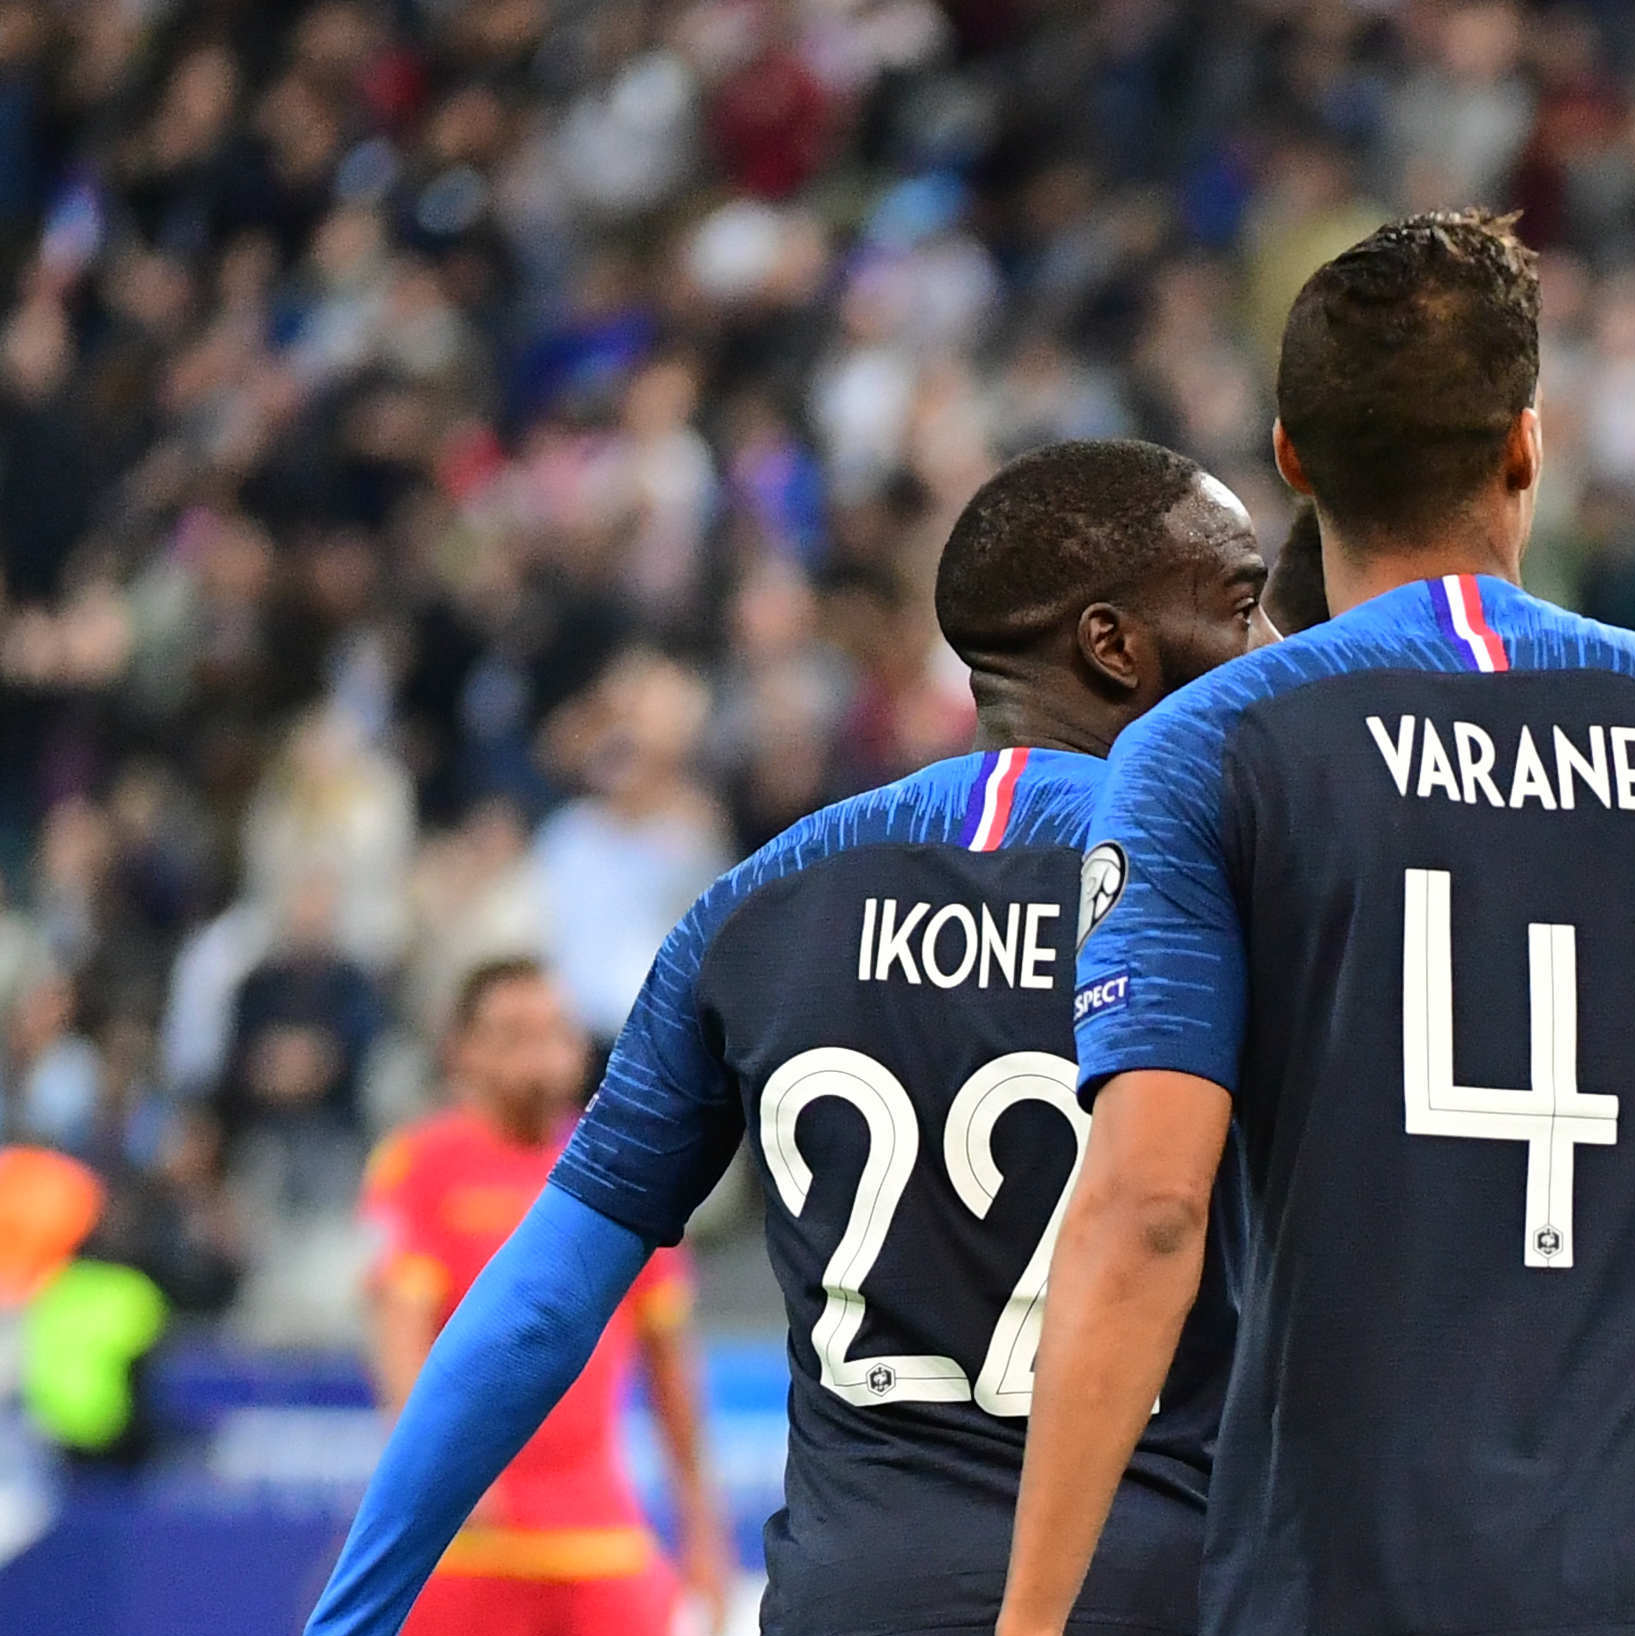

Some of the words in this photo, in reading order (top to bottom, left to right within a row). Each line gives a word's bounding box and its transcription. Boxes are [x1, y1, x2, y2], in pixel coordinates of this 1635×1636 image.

[858, 898, 1060, 989] IKONE
[1403, 868, 1619, 1268] 4
[760, 1046, 1160, 1417] 22
